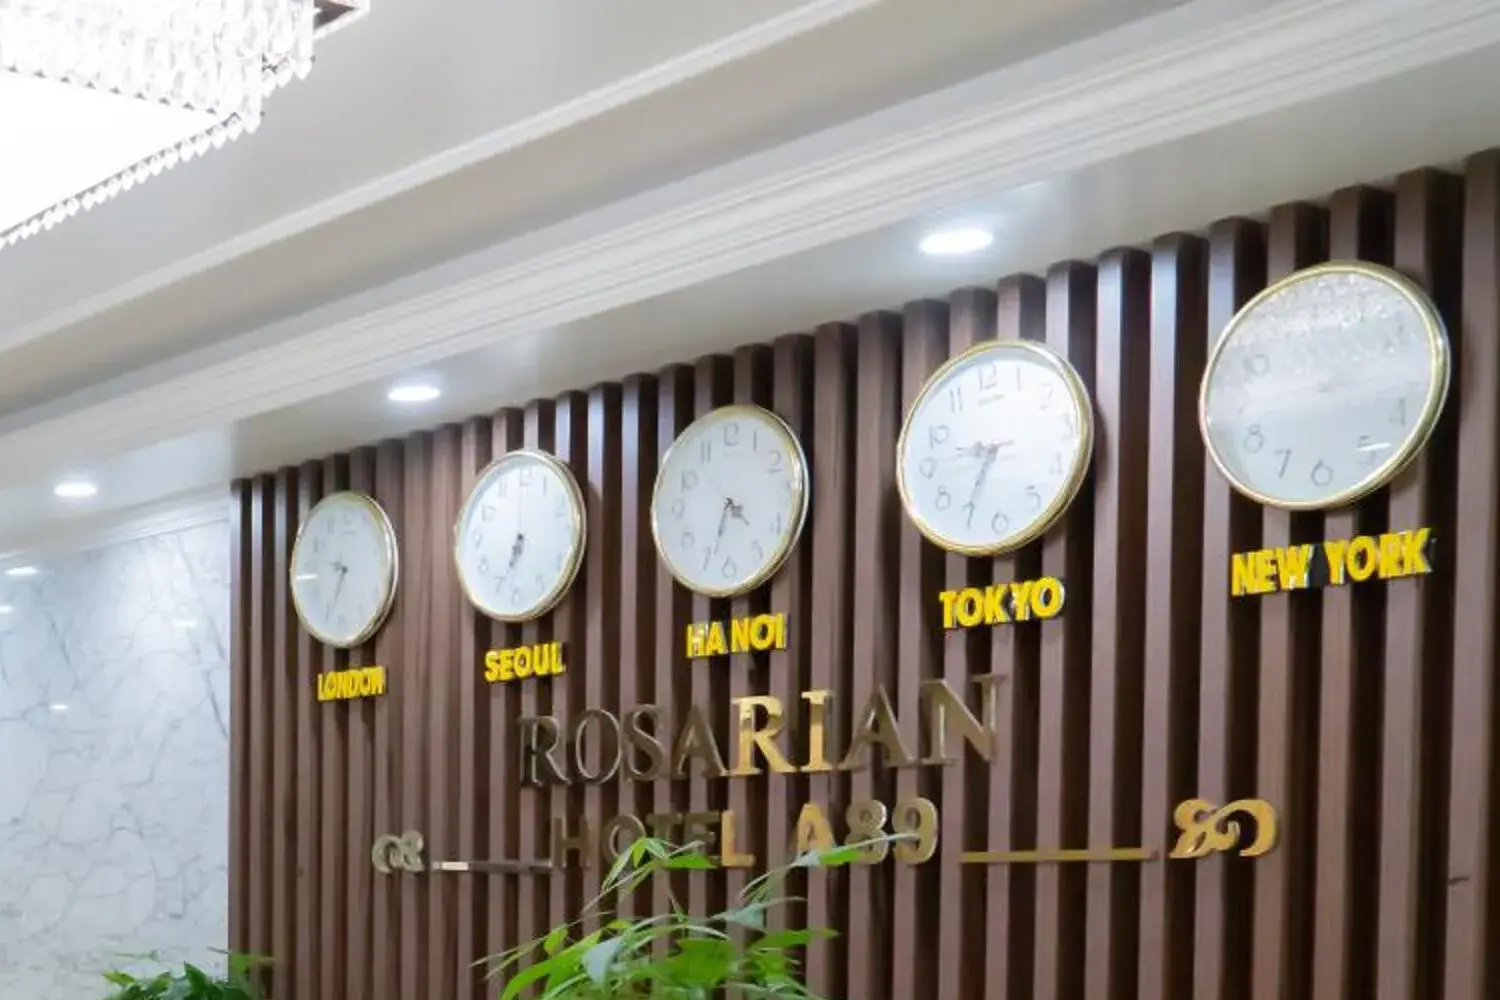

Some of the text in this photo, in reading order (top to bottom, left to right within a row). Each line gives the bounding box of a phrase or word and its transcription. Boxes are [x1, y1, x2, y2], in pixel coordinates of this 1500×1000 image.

[1243, 424, 1265, 455] 8
[1274, 448, 1291, 479] 7
[1310, 459, 1334, 487] 6
[1231, 527, 1433, 596] NEW YORK
[939, 575, 1066, 630] TOKYO
[317, 665, 386, 701] LONDON
[484, 641, 566, 683] SEOUL
[518, 673, 1005, 787] ROSARIAN
[550, 798, 938, 868] HOTEL A89
